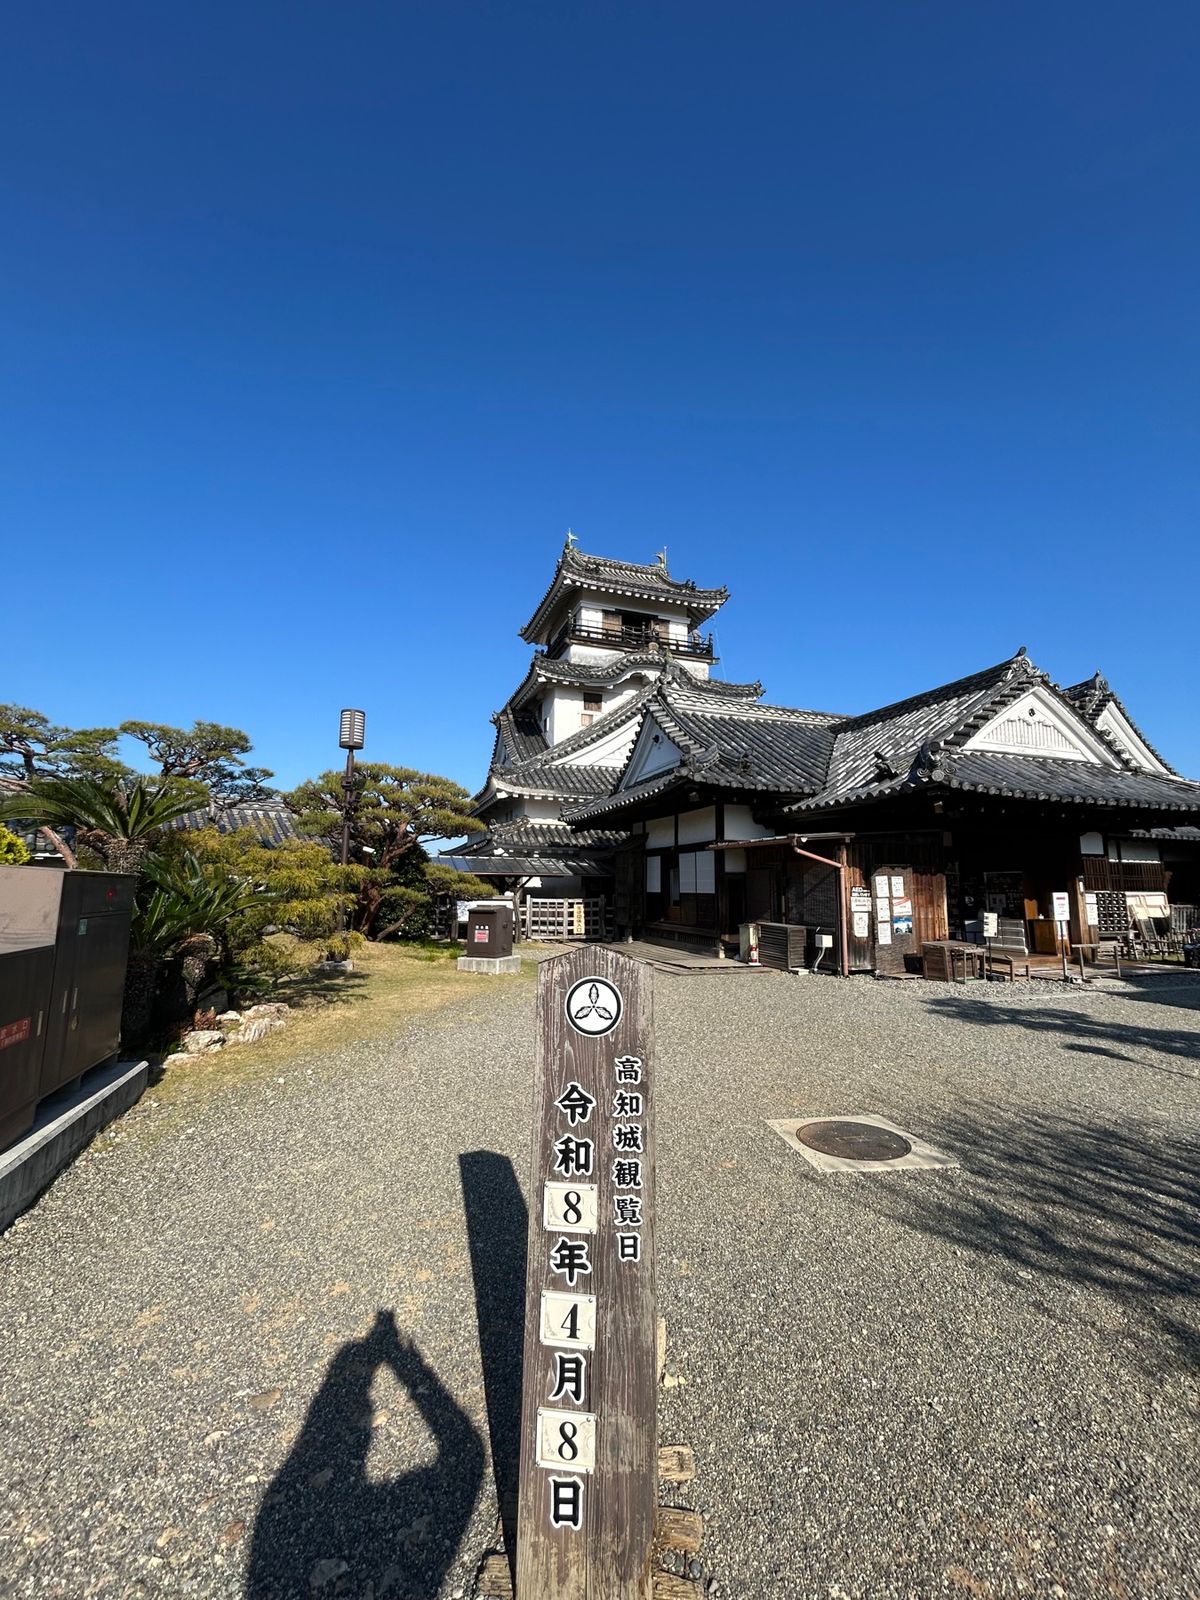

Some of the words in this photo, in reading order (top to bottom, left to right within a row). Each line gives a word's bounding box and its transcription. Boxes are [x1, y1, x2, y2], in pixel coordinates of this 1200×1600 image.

[548, 1081, 596, 1531] 令和8年4月8日
[614, 1055, 643, 1261] 高知城観覧日
